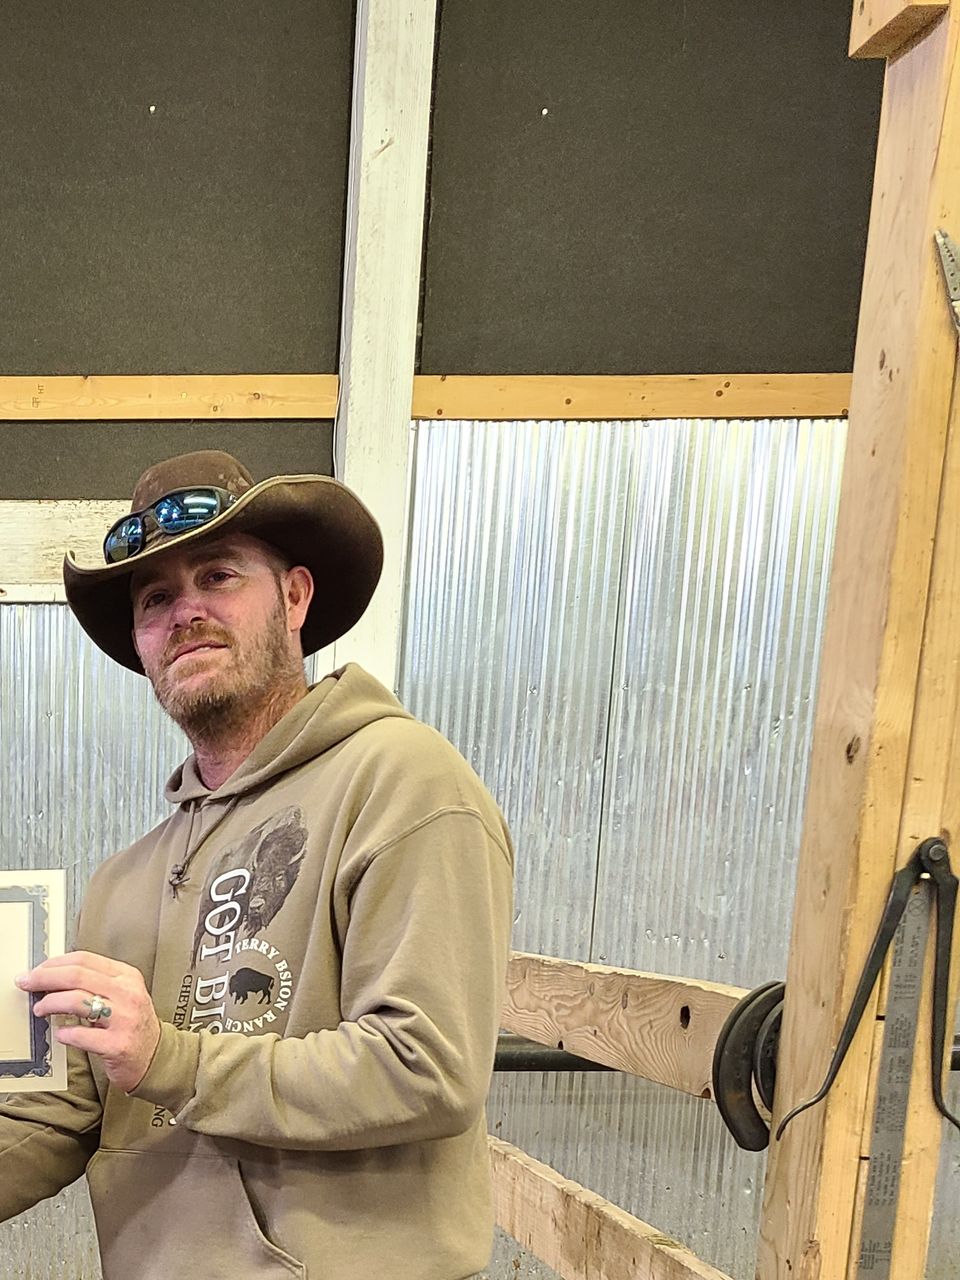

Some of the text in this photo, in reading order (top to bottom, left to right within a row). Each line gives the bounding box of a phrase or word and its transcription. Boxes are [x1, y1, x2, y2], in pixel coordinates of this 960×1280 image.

[201, 868, 251, 962] GOT
[225, 937, 293, 1033] TERRY BSION RANCH
